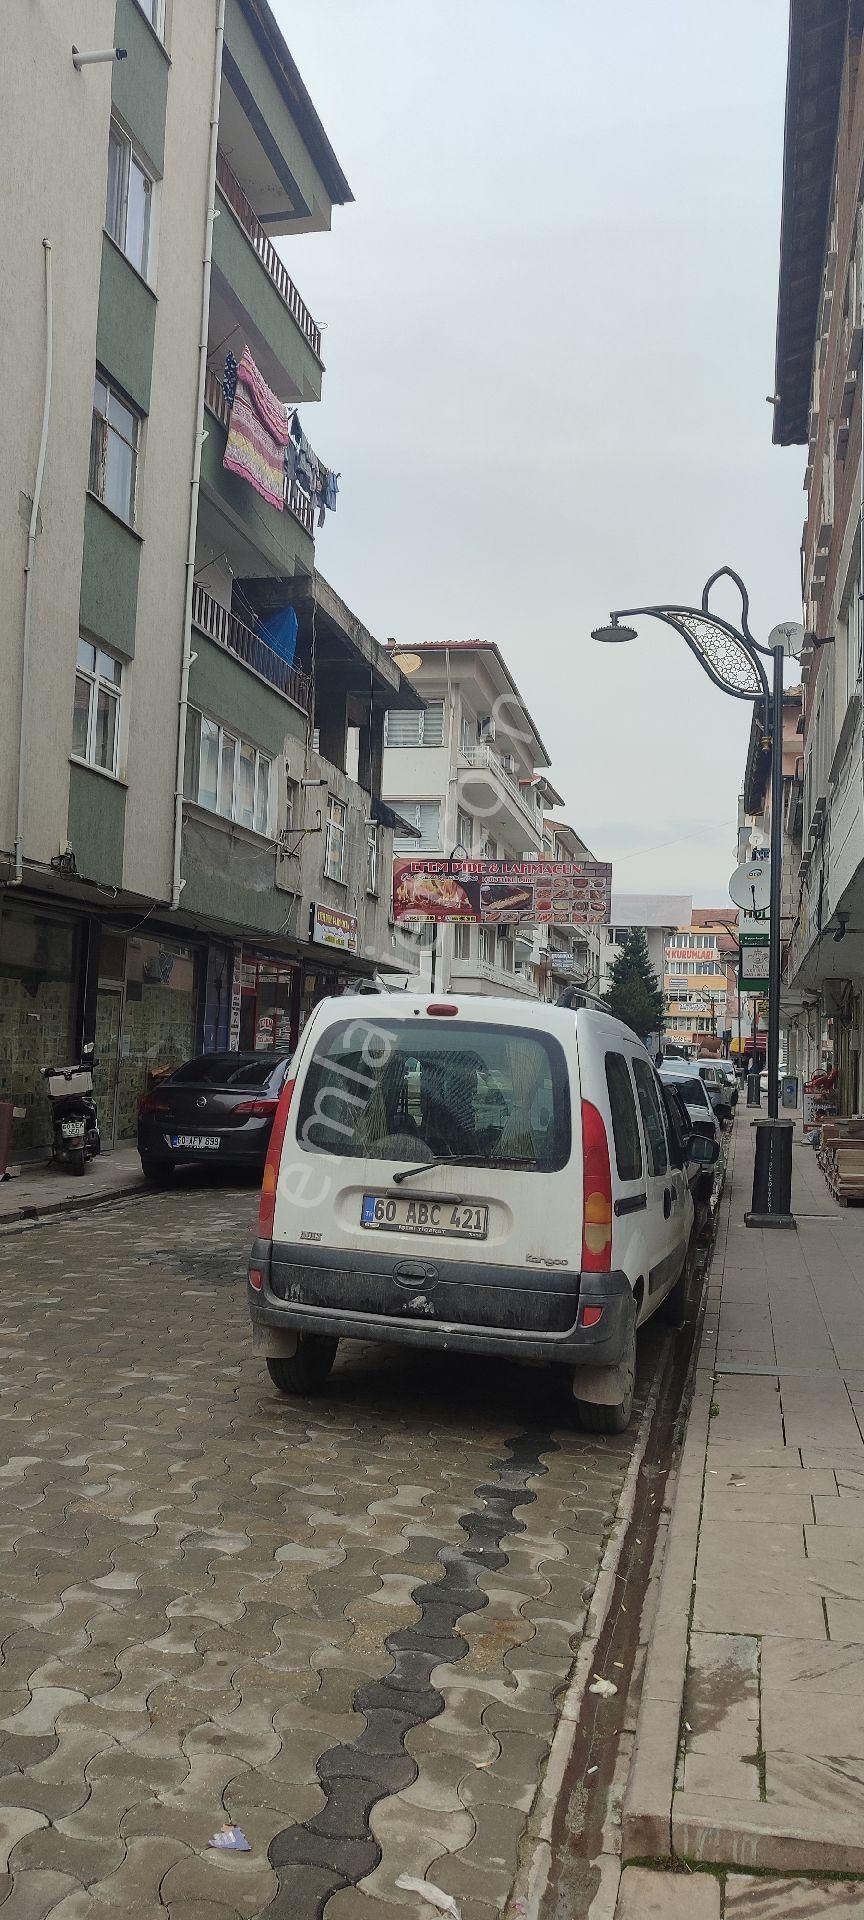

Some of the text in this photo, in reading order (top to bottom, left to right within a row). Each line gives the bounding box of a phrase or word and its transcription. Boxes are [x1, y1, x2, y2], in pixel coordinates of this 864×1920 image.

[501, 863, 583, 875] LAHMACUN
[671, 949, 714, 960] KURUMLARI
[374, 1199, 482, 1231] 60 ABC 421
